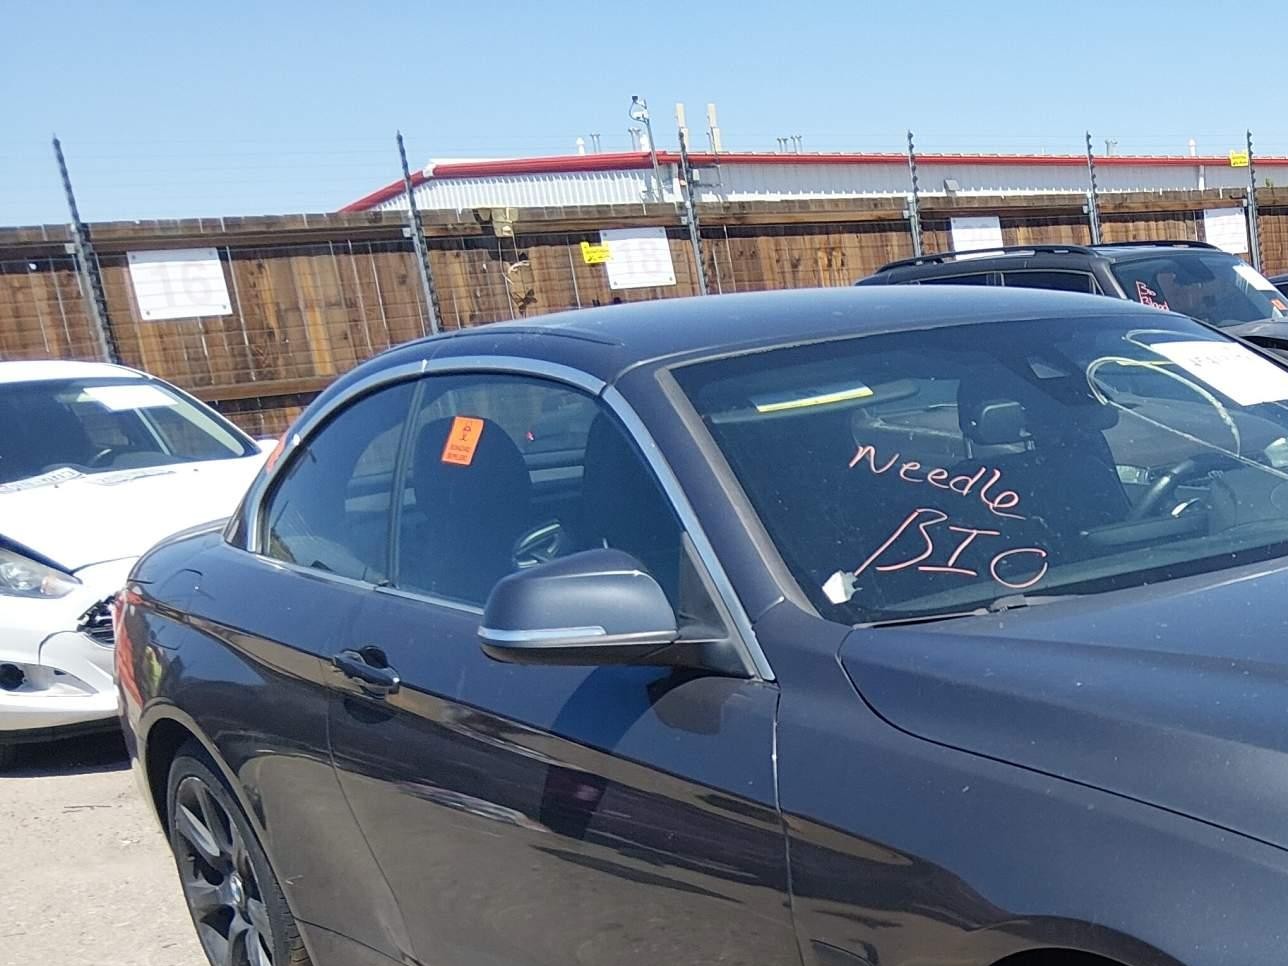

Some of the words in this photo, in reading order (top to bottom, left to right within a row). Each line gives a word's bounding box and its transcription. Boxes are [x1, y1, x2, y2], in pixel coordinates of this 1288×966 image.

[152, 264, 213, 308] 16
[849, 445, 1027, 520] Needle
[854, 508, 1048, 588] BIO
